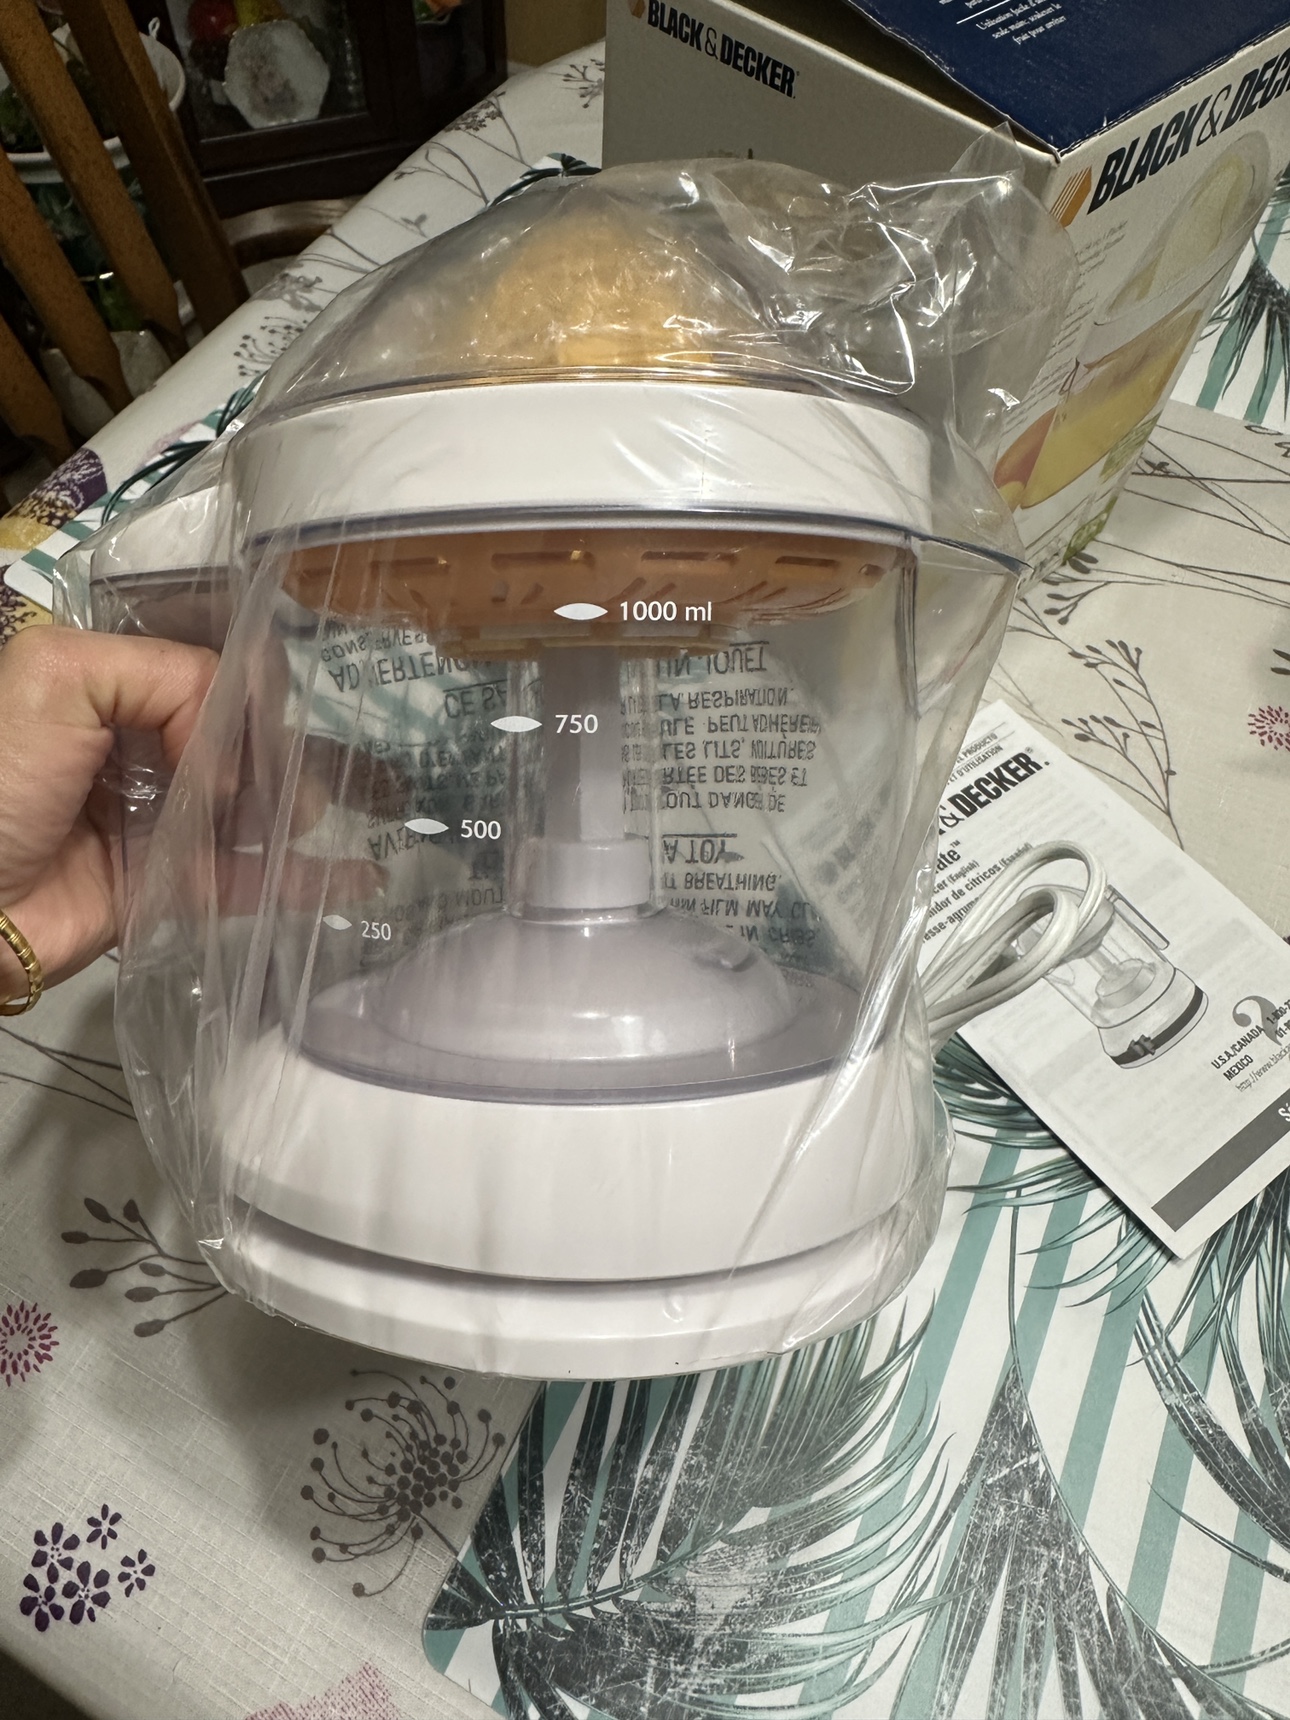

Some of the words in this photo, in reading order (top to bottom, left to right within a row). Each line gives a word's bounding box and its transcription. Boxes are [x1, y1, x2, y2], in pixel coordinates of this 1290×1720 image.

[648, 0, 704, 51] BLACK
[1086, 94, 1213, 215] BLACK
[619, 602, 677, 621] 1000
[685, 601, 712, 621] ml
[555, 714, 598, 734] 750
[461, 821, 502, 839] 500
[932, 879, 949, 894] cer
[951, 888, 966, 900] de
[361, 922, 391, 941] 250
[1223, 1054, 1254, 1081] MEXICO
